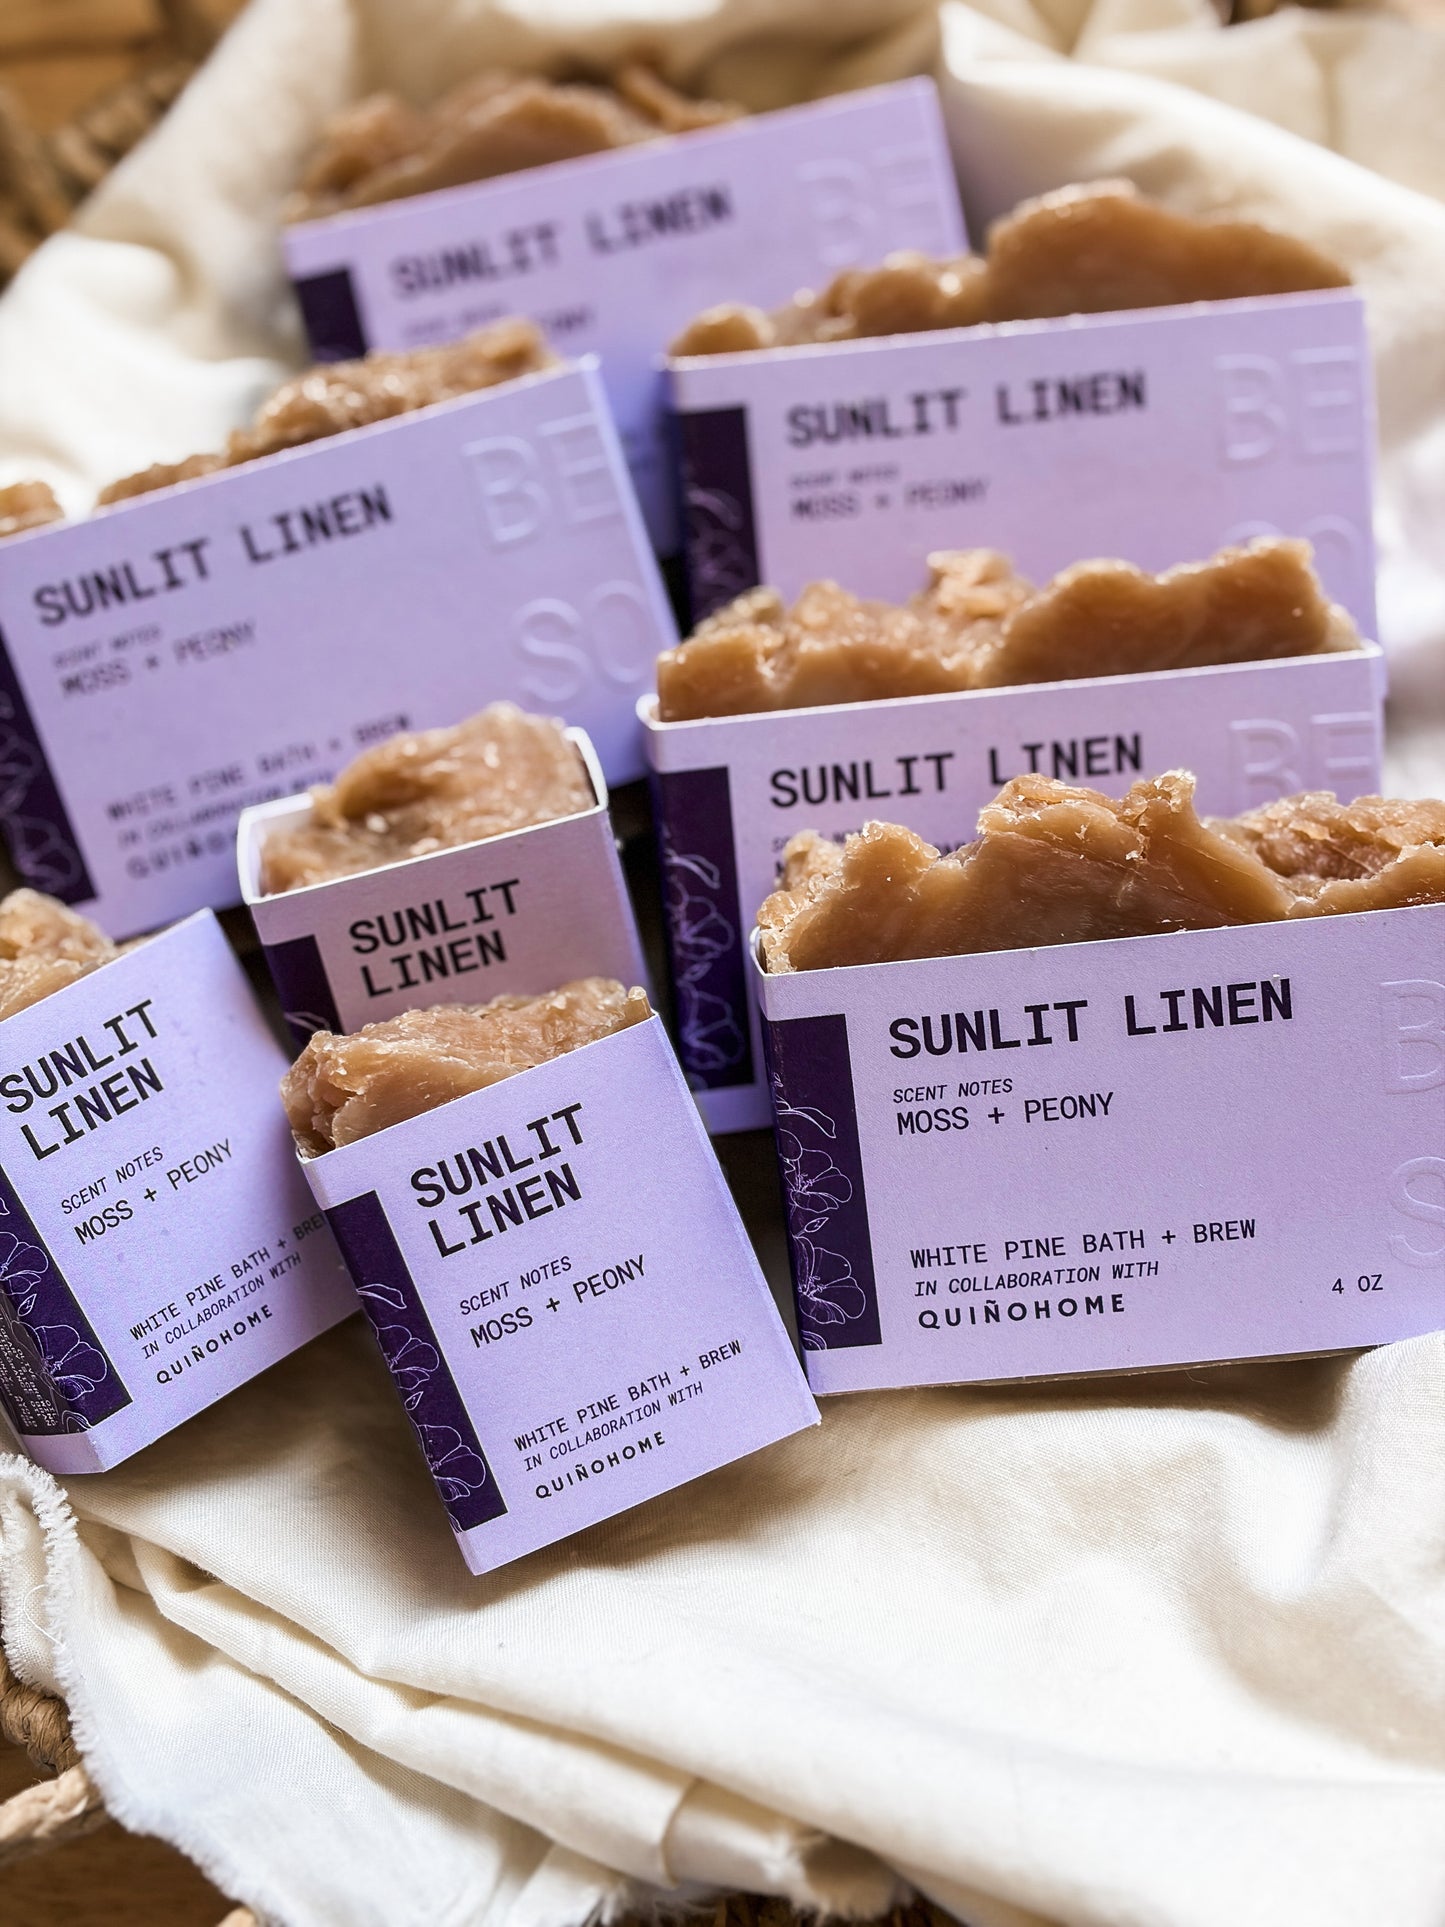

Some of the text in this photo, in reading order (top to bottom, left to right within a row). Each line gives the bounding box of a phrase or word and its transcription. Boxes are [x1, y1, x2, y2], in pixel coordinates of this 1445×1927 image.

[390, 184, 732, 300] SUNLIT LINEN
[786, 370, 1147, 449] SUNLIT LINEN
[33, 484, 393, 627] SUNLIT LINEN
[770, 733, 1142, 808] SUNLIT LINEN
[349, 879, 519, 954] SUNLIT
[361, 930, 506, 998] LINEN
[0, 1000, 157, 1113] SUNLIT
[889, 978, 1292, 1058] SUNLIT LINEN
[21, 1058, 163, 1160] LINEN
[893, 1078, 1012, 1103] SCENT NOTES
[897, 1107, 969, 1135] MOSS
[1024, 1092, 1113, 1123] PEONY
[61, 1147, 163, 1214] SCENT NOTES
[74, 1199, 134, 1245] MOSS
[167, 1139, 231, 1190] PEONY
[411, 1103, 583, 1207] SUNLIT
[428, 1163, 582, 1258] LINEN
[910, 1244, 988, 1268] WHITE
[1005, 1237, 1066, 1260] PINE
[1083, 1230, 1144, 1253] BATH
[1193, 1219, 1255, 1243] BREW
[130, 1303, 180, 1340] WHITE
[186, 1274, 226, 1306] PINE
[231, 1247, 270, 1278] BATH
[293, 1212, 325, 1240] BRE
[142, 1251, 302, 1359] IN COLLABORATION WITH
[460, 1256, 571, 1315] SCENT NOTES
[470, 1307, 532, 1348] MOSS
[573, 1254, 644, 1303] PEONY
[915, 1261, 1158, 1296] IN COLLABORATION WITH
[919, 1294, 1124, 1329] QUIÑOHOME
[1332, 1274, 1383, 1294] 4 OZ
[157, 1304, 273, 1383] QUIÑOHOME
[514, 1417, 569, 1451] WHITE
[577, 1394, 620, 1424] PINE
[628, 1372, 671, 1401] BATH
[699, 1340, 741, 1369] BREW
[524, 1381, 702, 1471] IN COLLABORATION WITH
[536, 1432, 665, 1498] QUIÑOHOME
